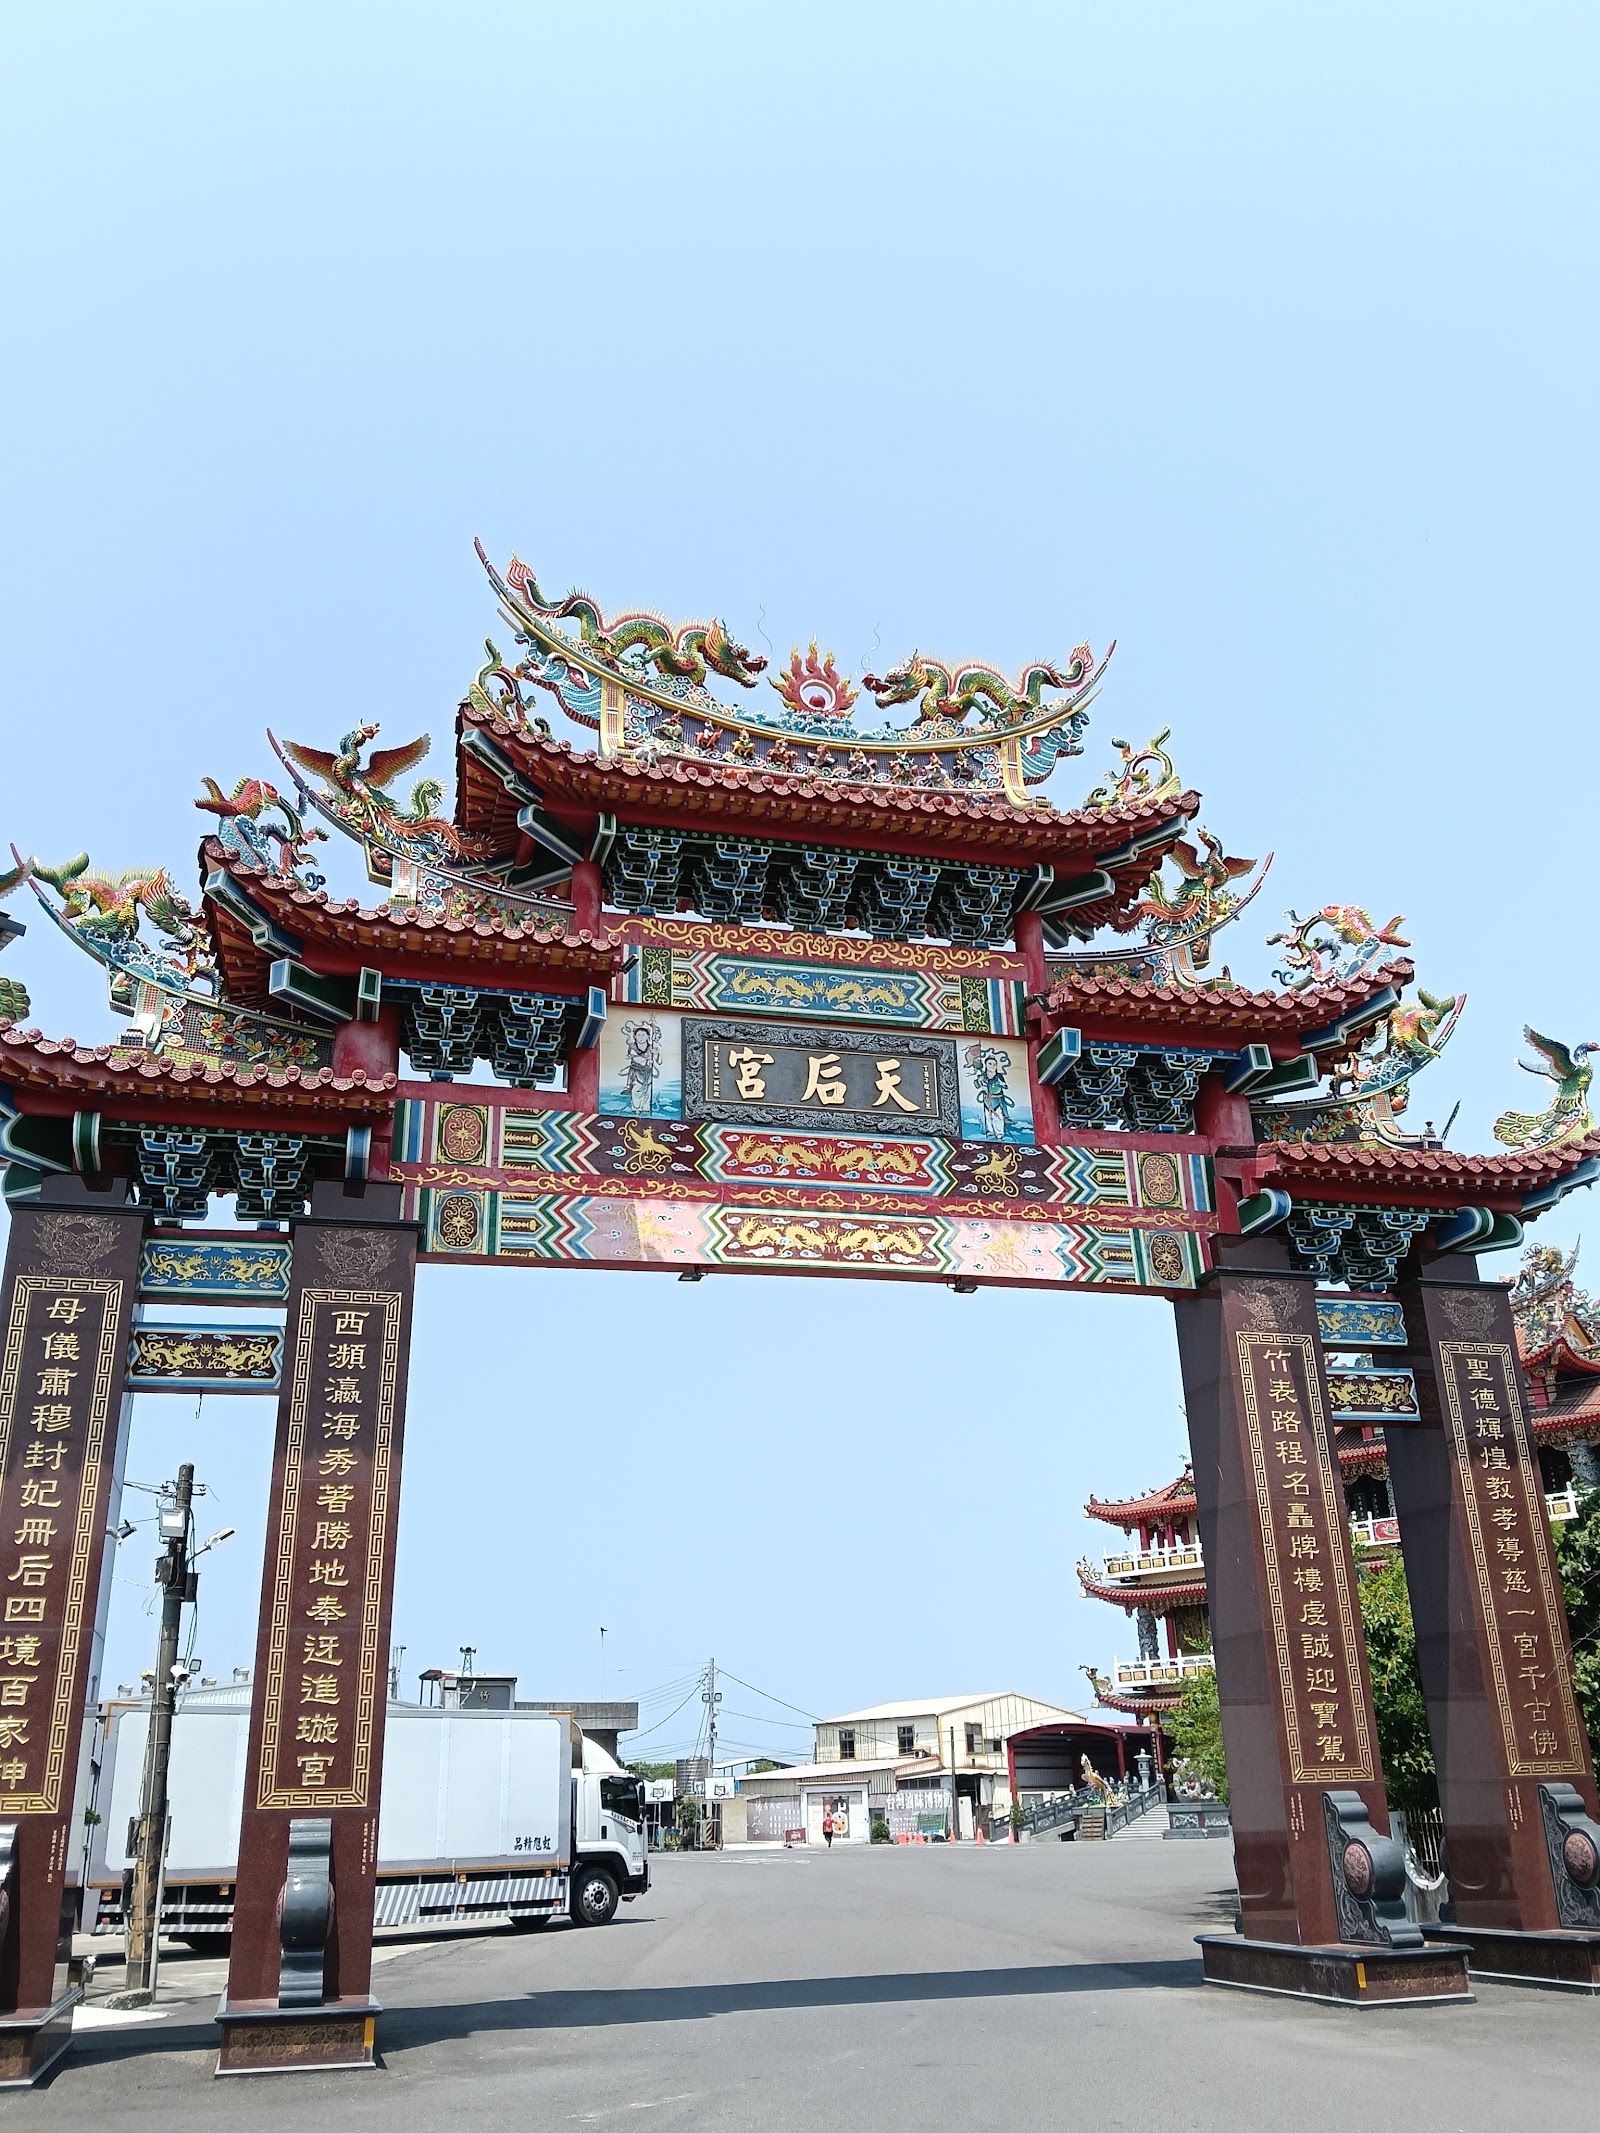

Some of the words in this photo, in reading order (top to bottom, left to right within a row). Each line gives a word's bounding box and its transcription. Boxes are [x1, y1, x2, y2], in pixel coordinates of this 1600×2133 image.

[729, 1047, 920, 1112] 天后宮
[1466, 1358, 1558, 1756] 聖德輝煌教孝導慈一宮千古佛
